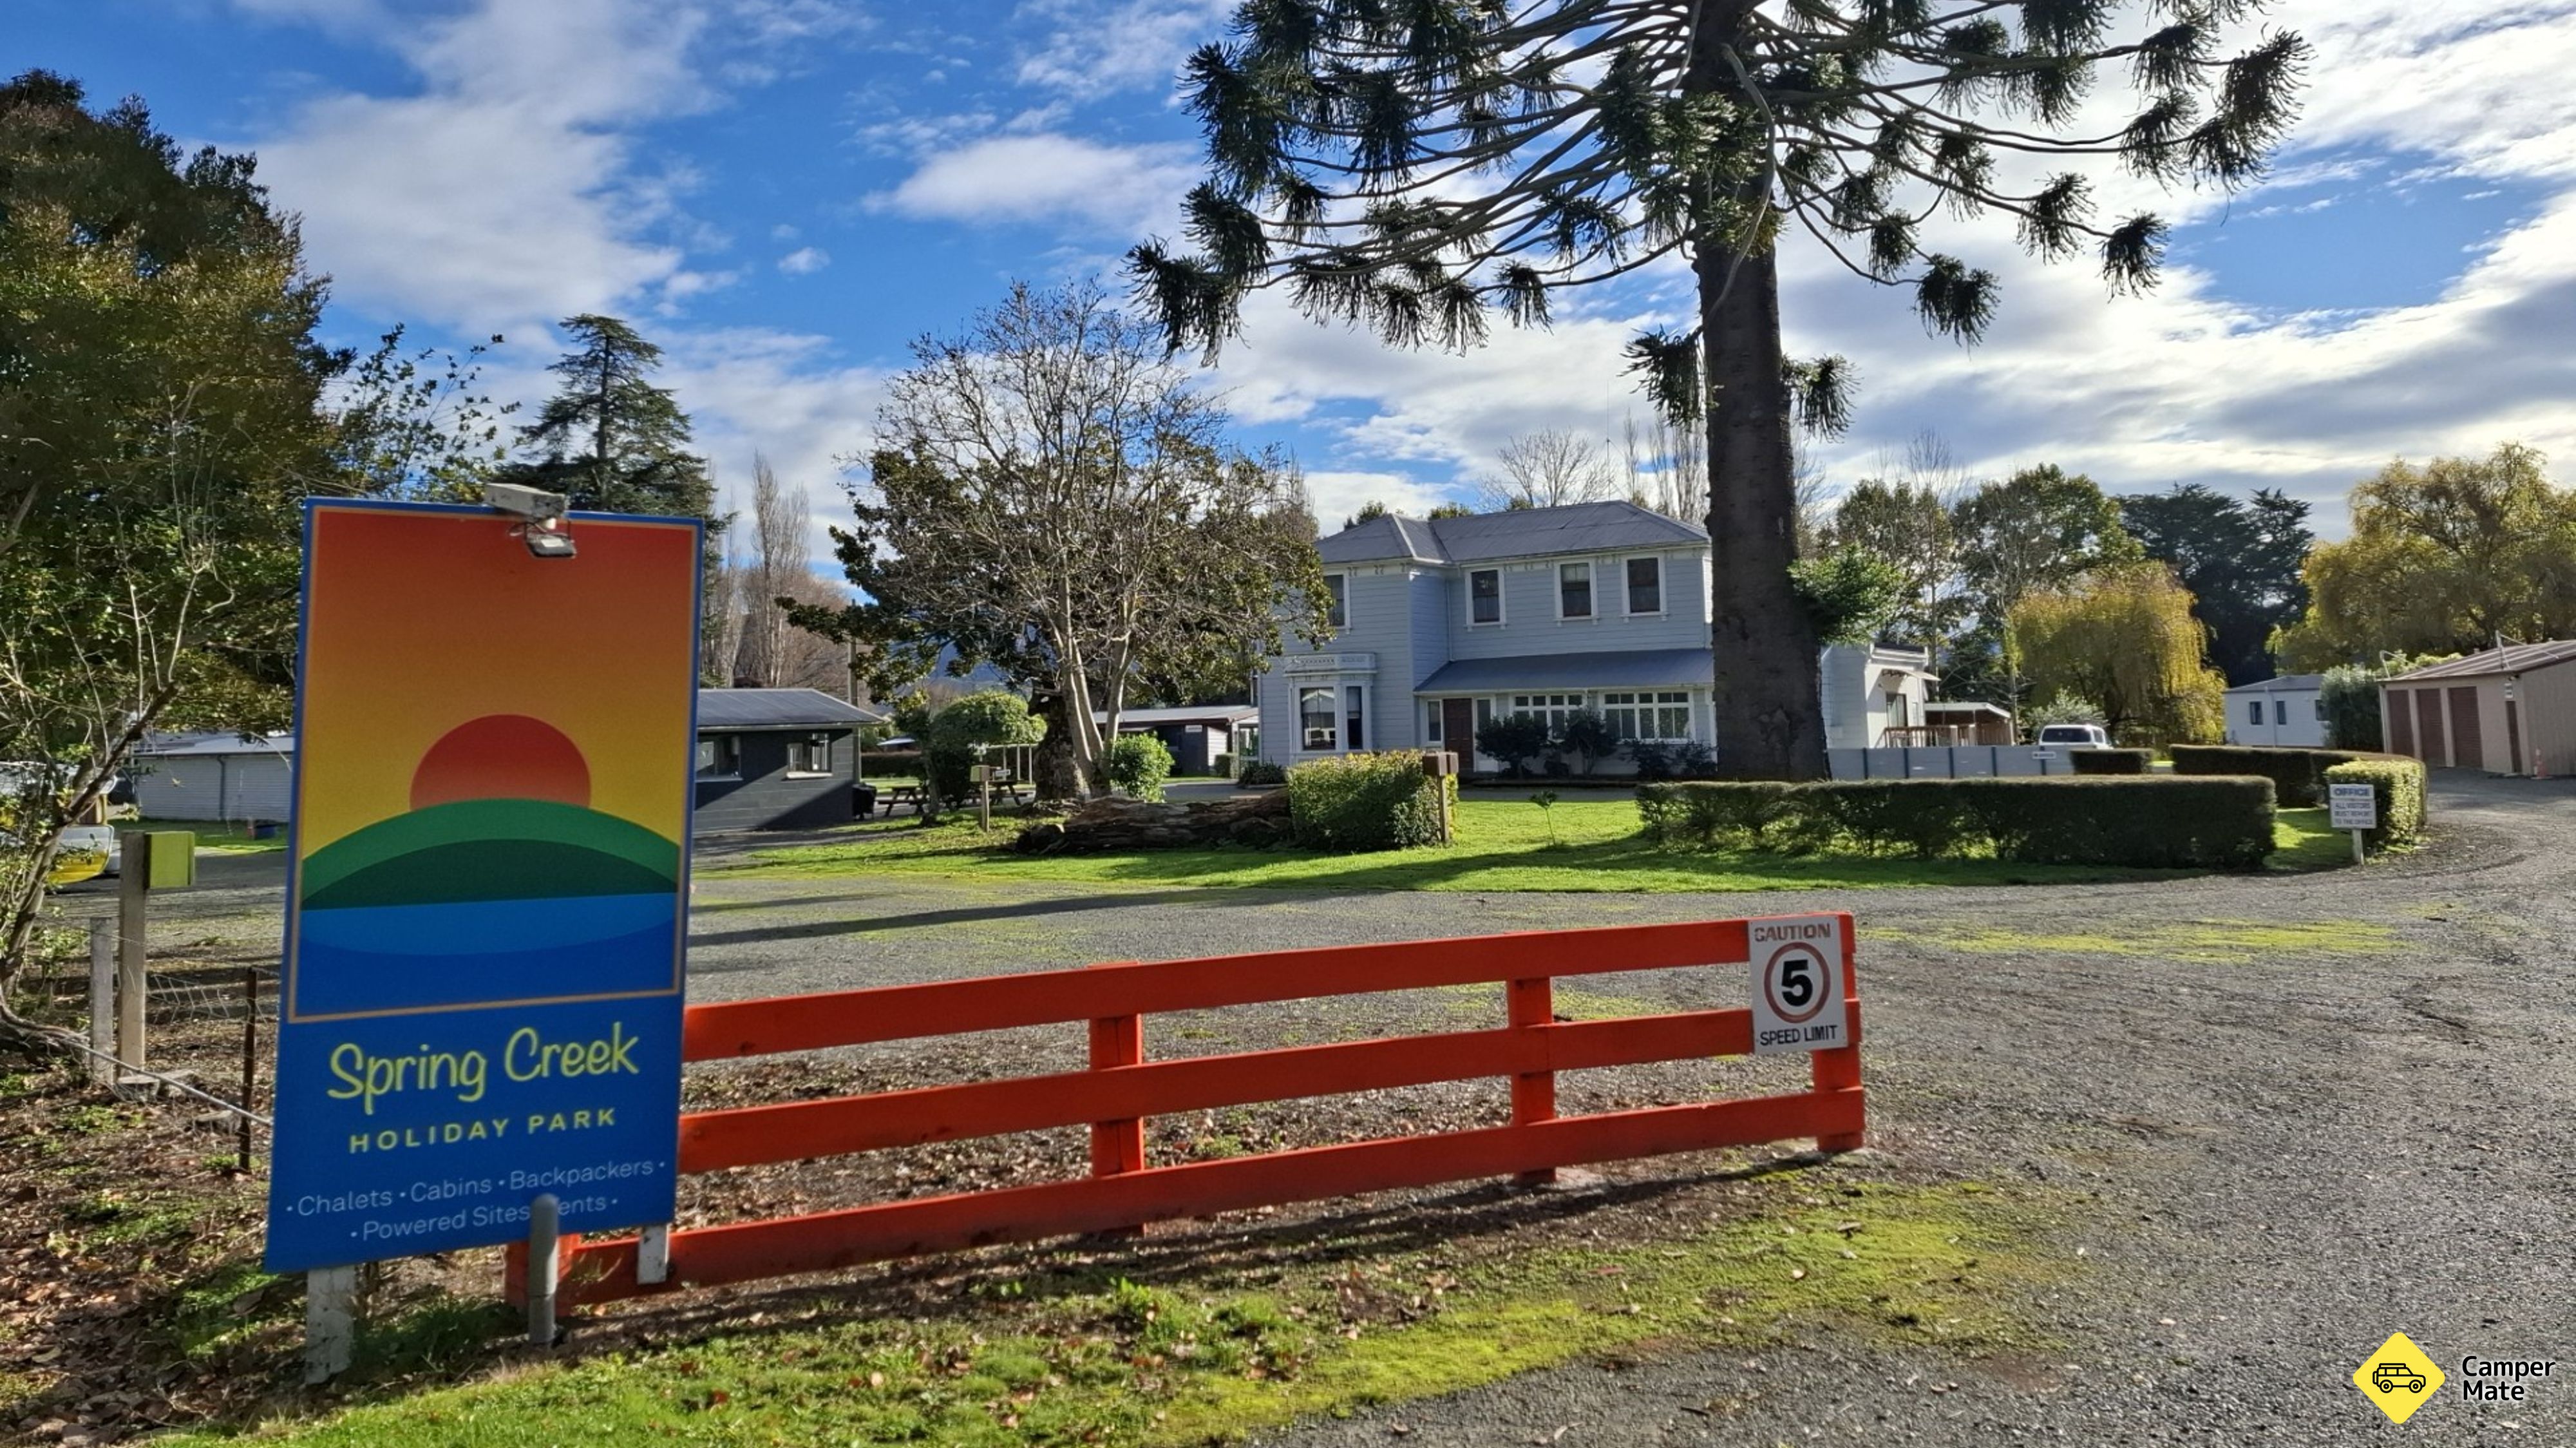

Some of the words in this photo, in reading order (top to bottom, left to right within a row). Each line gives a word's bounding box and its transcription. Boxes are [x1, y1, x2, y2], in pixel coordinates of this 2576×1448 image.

[2334, 788, 2370, 796] OFFICE
[1754, 923, 1831, 942] CAUTION
[1781, 959, 1813, 1007] 5
[1759, 1028, 1801, 1046] SPEED
[1804, 1025, 1838, 1042] LIMIT
[327, 1042, 487, 1115] Spring
[504, 1022, 639, 1082] Creek
[348, 1118, 509, 1153] HOLIDAY
[527, 1109, 616, 1134] PARK
[298, 1190, 393, 1216] Chalets
[410, 1178, 492, 1203] Cabins
[510, 1160, 653, 1190] Backpackers
[363, 1212, 466, 1241] Powered
[472, 1203, 531, 1226] Sites
[557, 1196, 606, 1216] ents
